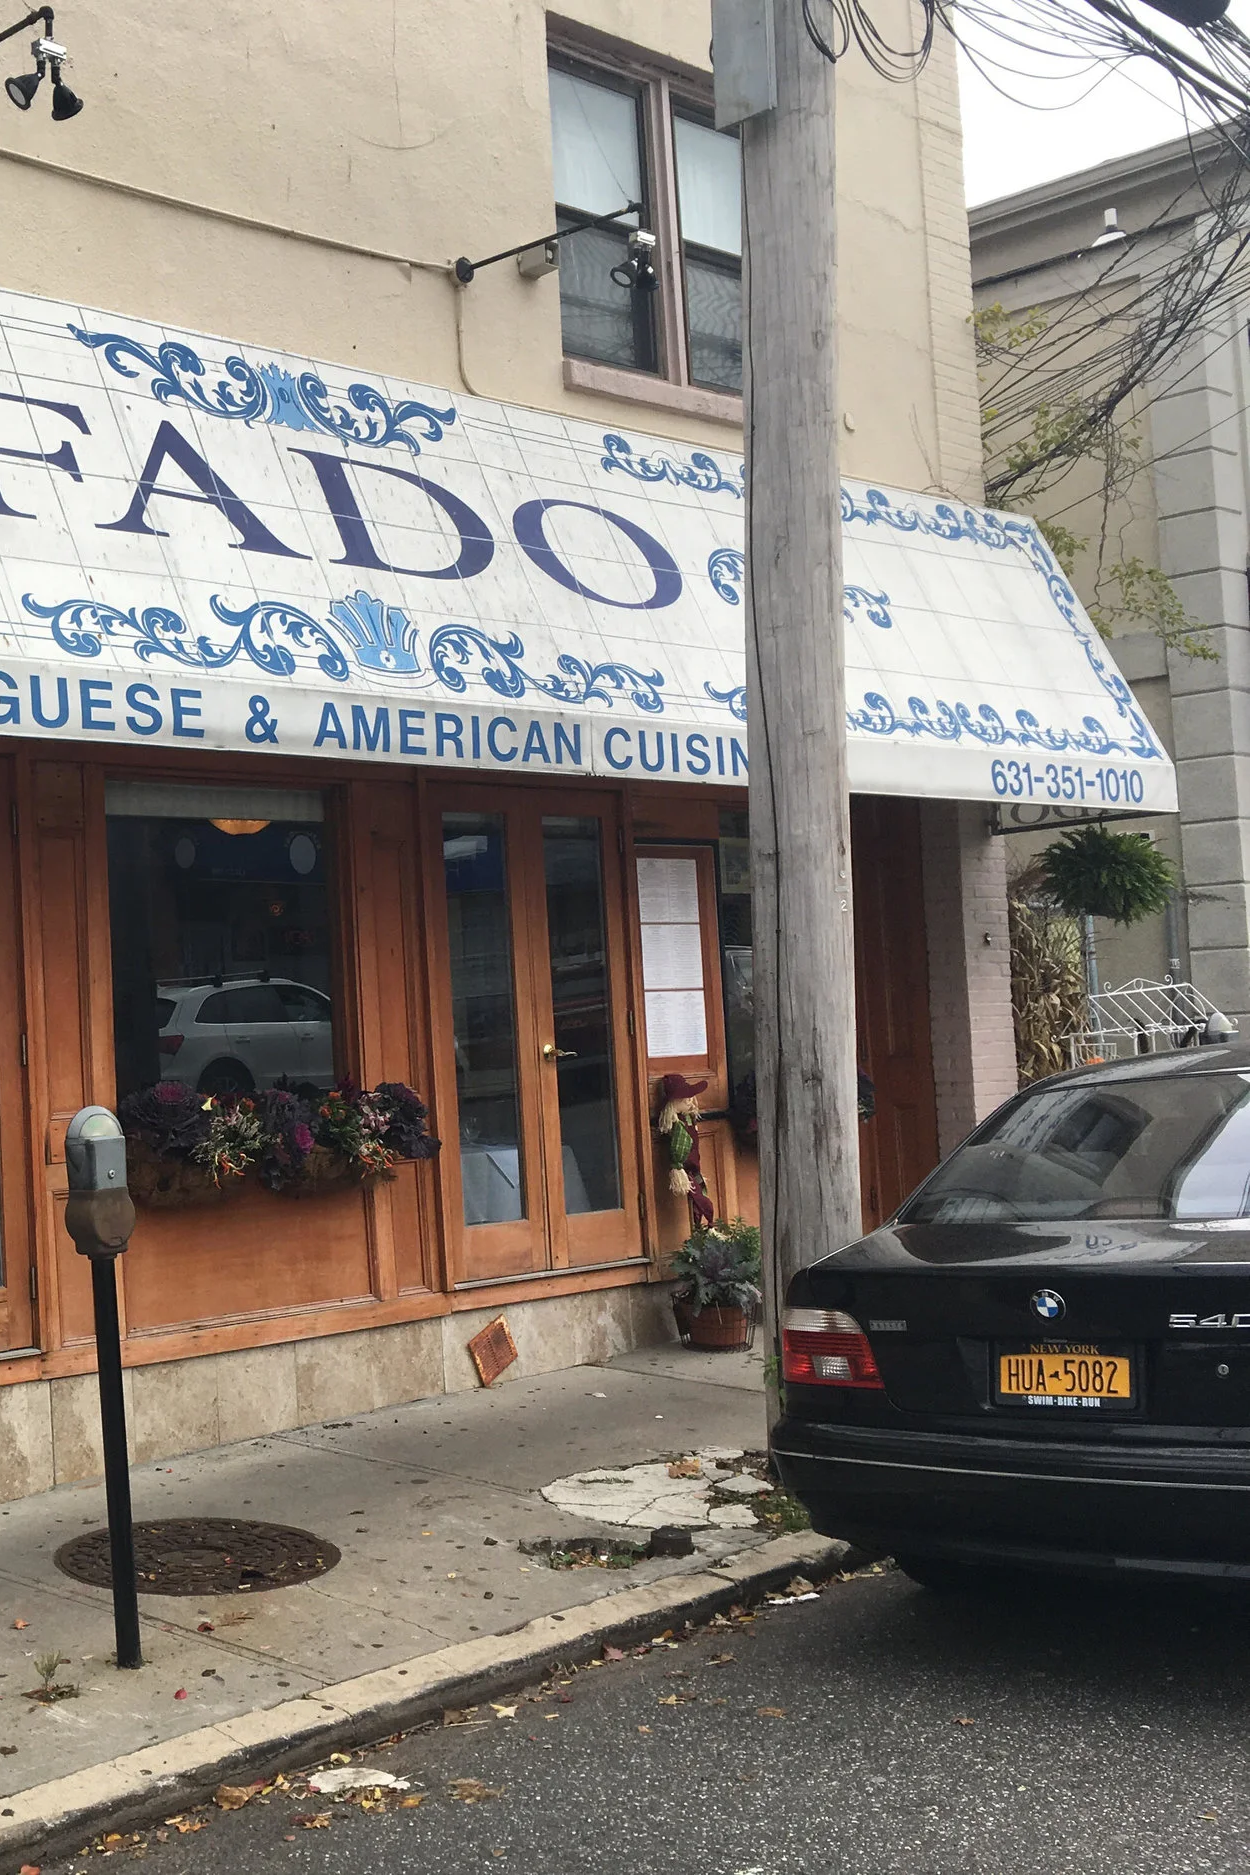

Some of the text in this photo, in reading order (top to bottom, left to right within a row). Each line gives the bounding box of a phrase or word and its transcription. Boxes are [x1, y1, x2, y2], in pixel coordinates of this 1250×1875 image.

[245, 695, 280, 744] &
[313, 702, 583, 765] AMERICAN
[991, 759, 1144, 804] 631-351-1010
[1030, 1343, 1100, 1355] NEW YORK
[1007, 1358, 1119, 1394] HUA 5082
